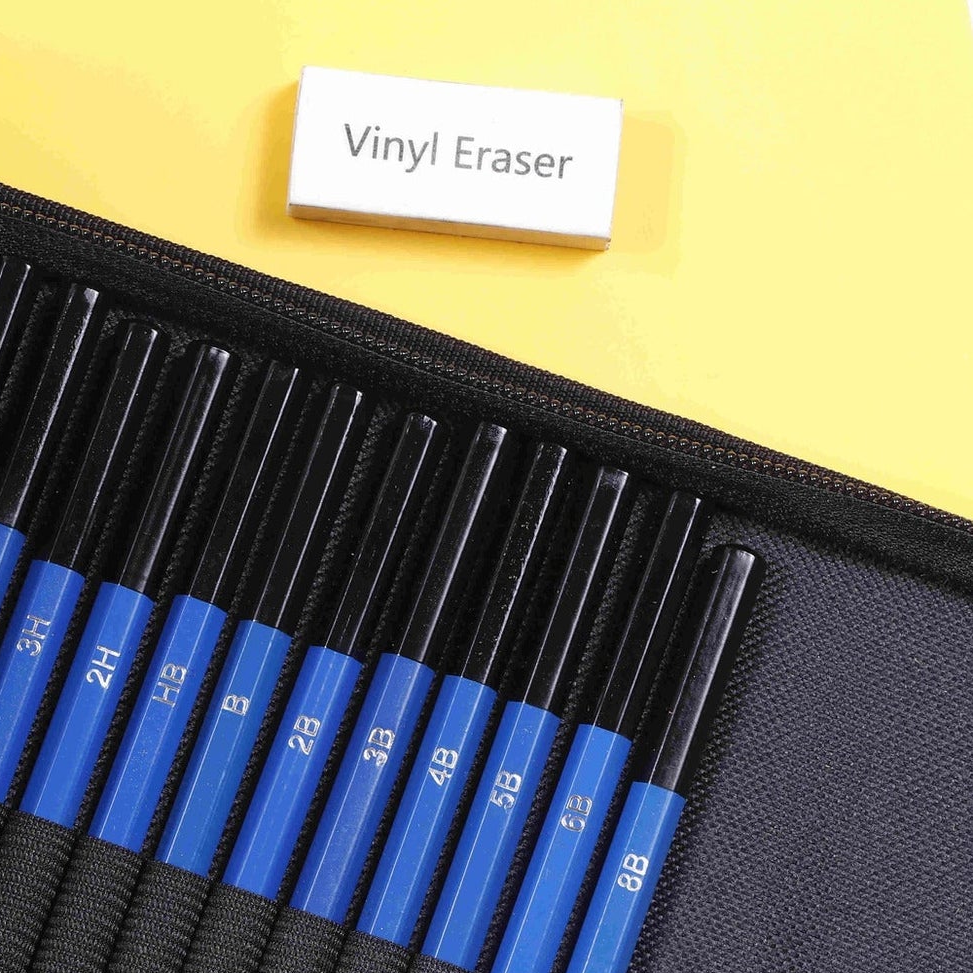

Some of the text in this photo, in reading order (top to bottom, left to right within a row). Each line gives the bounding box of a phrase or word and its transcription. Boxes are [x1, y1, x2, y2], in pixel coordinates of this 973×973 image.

[343, 123, 573, 179] Vinyl Eraser
[16, 614, 51, 657] 3H
[86, 644, 121, 690] 2H
[152, 662, 188, 708] HB
[221, 694, 250, 717] B
[288, 714, 321, 756] 2B
[363, 726, 396, 767] 3B
[427, 747, 459, 787] 4B
[489, 770, 522, 811] 5B
[560, 794, 593, 833] 6B
[617, 852, 649, 893] 8B
